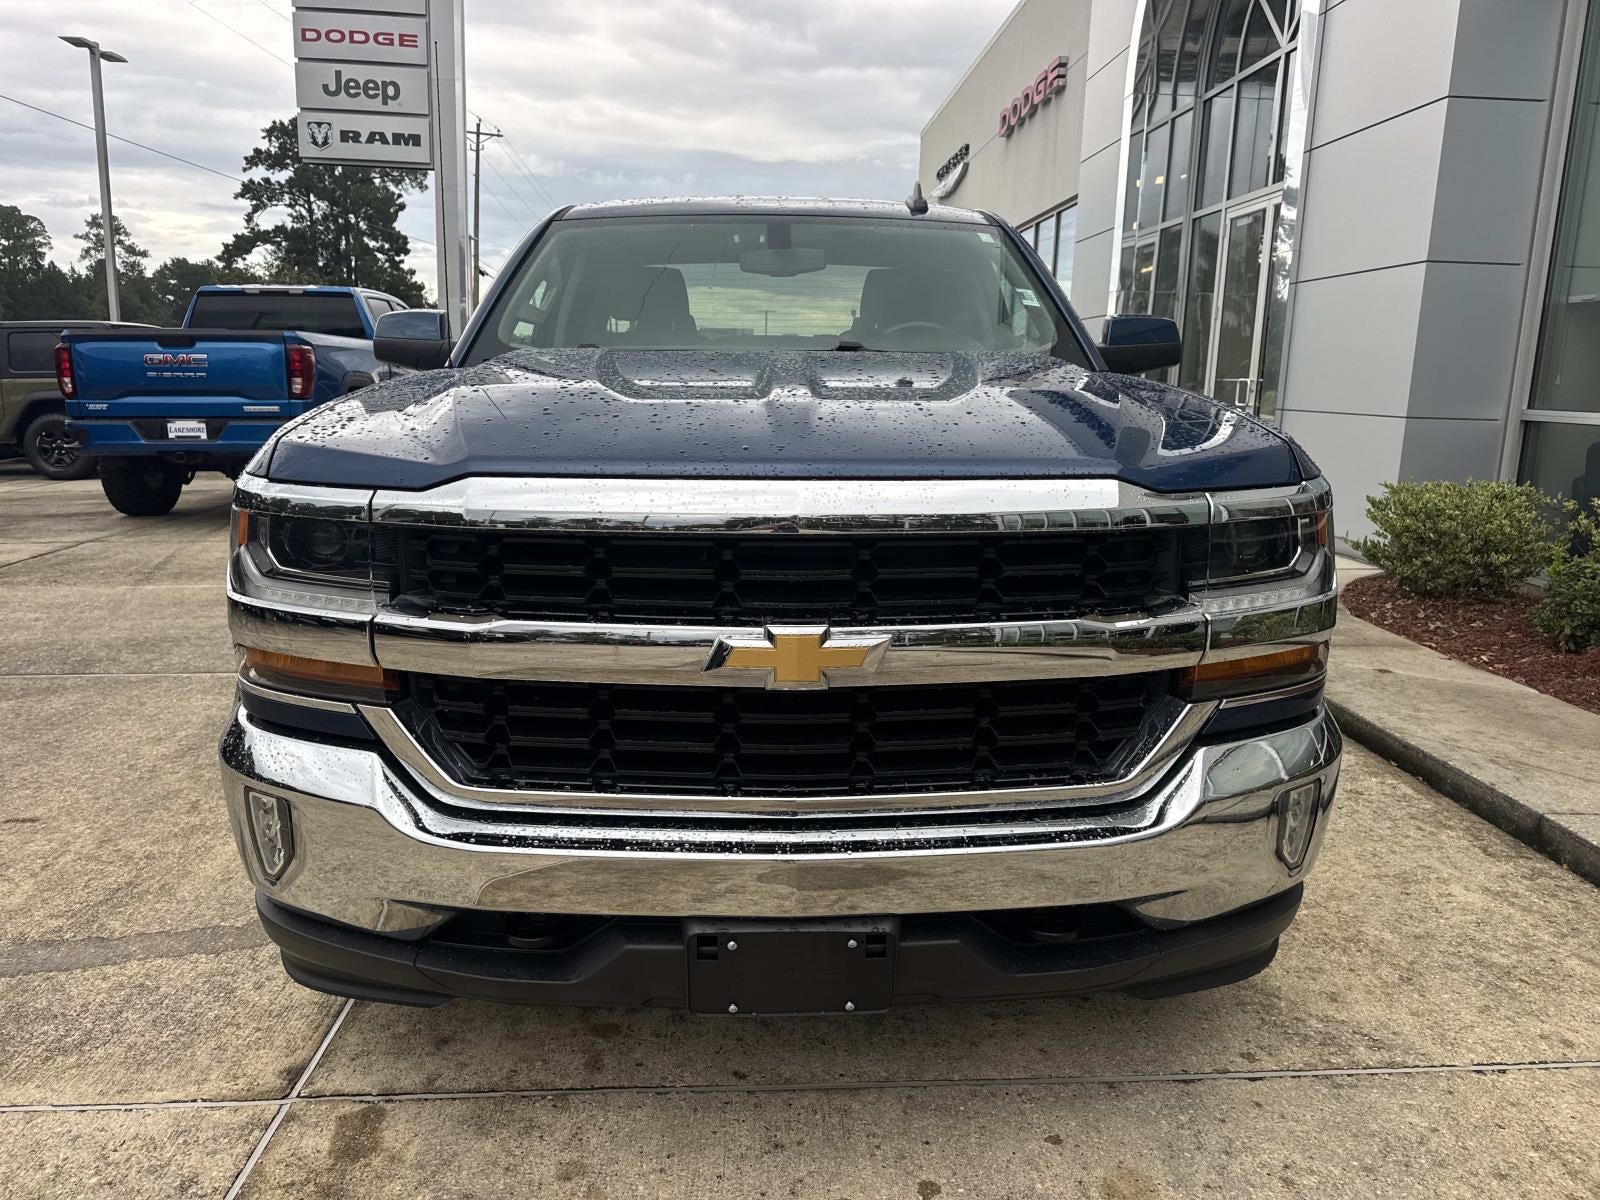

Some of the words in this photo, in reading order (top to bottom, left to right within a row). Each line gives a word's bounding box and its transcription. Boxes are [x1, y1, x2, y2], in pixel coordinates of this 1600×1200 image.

[300, 28, 418, 48] DODGE
[321, 69, 401, 106] Jeep
[998, 55, 1069, 138] DODGE
[339, 129, 422, 147] RAM
[143, 353, 208, 367] GMC
